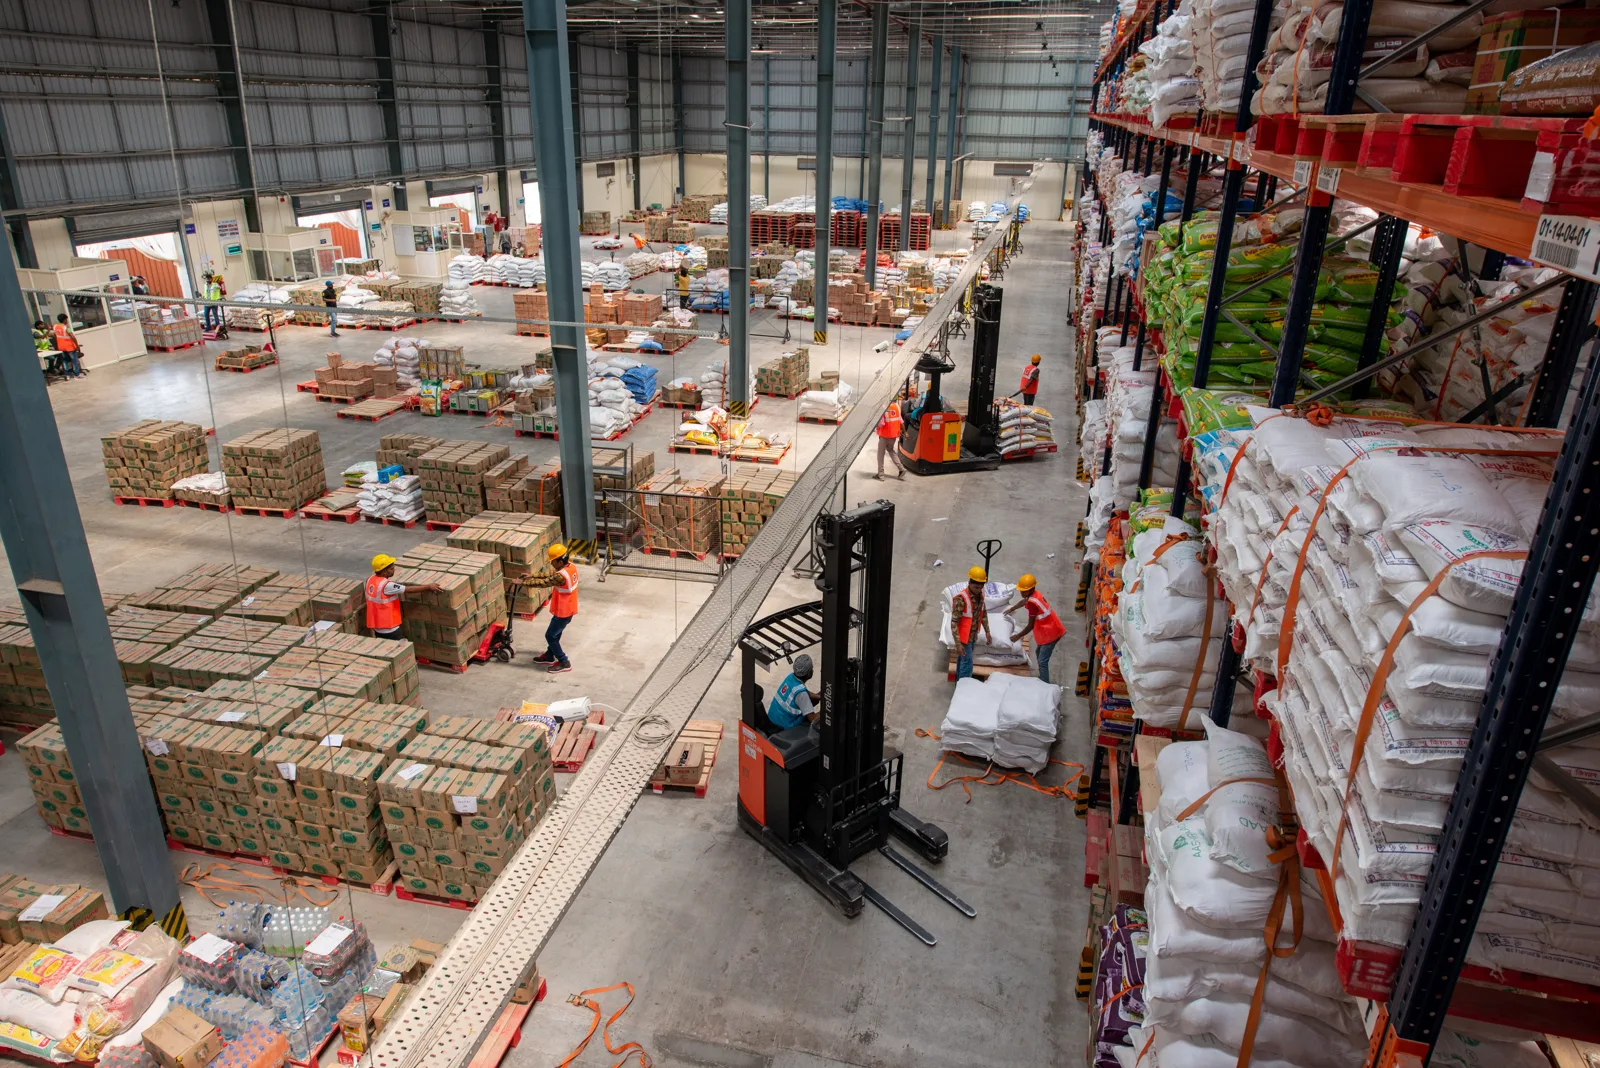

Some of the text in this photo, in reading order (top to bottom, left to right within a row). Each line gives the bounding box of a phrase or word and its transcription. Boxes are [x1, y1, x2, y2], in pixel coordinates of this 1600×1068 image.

[1539, 218, 1591, 247] 01-14-04-01
[824, 682, 832, 727] BT reflex
[1429, 738, 1453, 746] किसान
